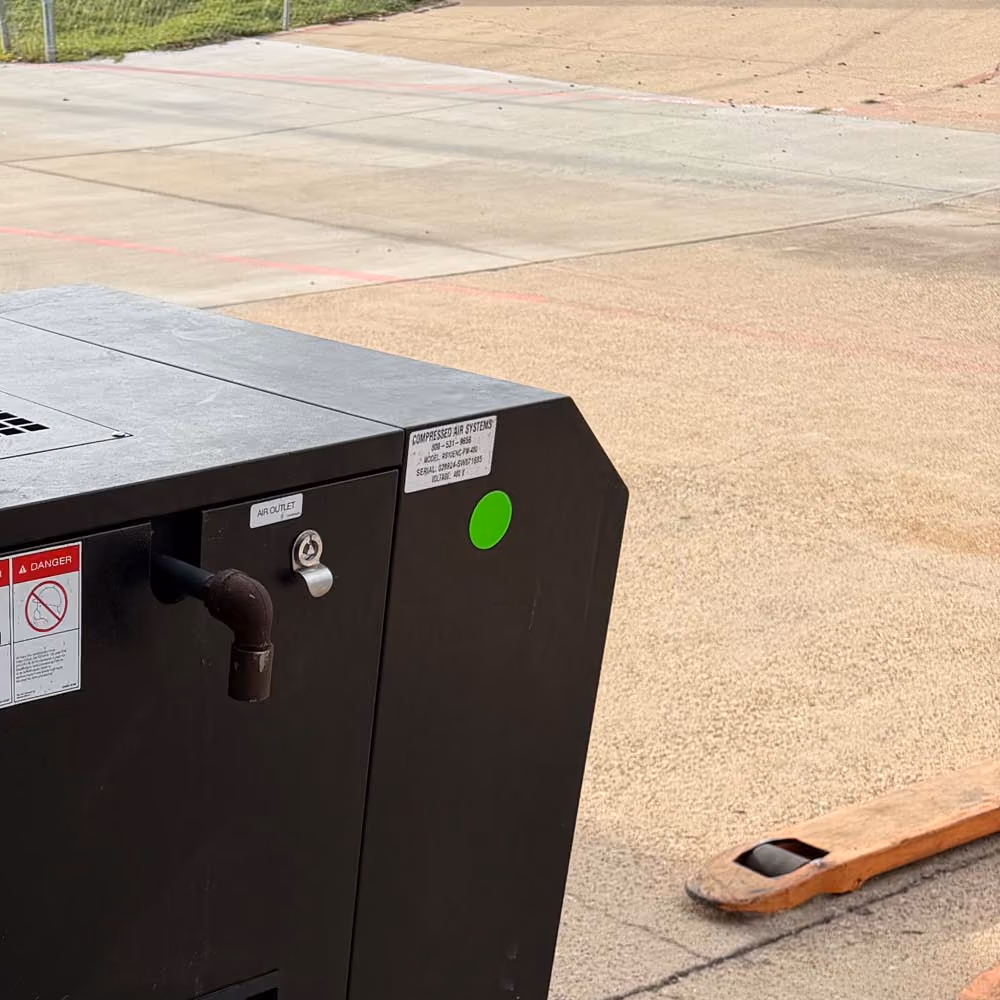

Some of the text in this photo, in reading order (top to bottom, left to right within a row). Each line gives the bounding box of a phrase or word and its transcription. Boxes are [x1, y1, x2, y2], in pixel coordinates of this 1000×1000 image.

[412, 419, 493, 445] COMPRESSED AIR SYSTEMS
[257, 507, 269, 518] AIR
[270, 501, 296, 514] OUTLET
[30, 555, 72, 572] DANGER
